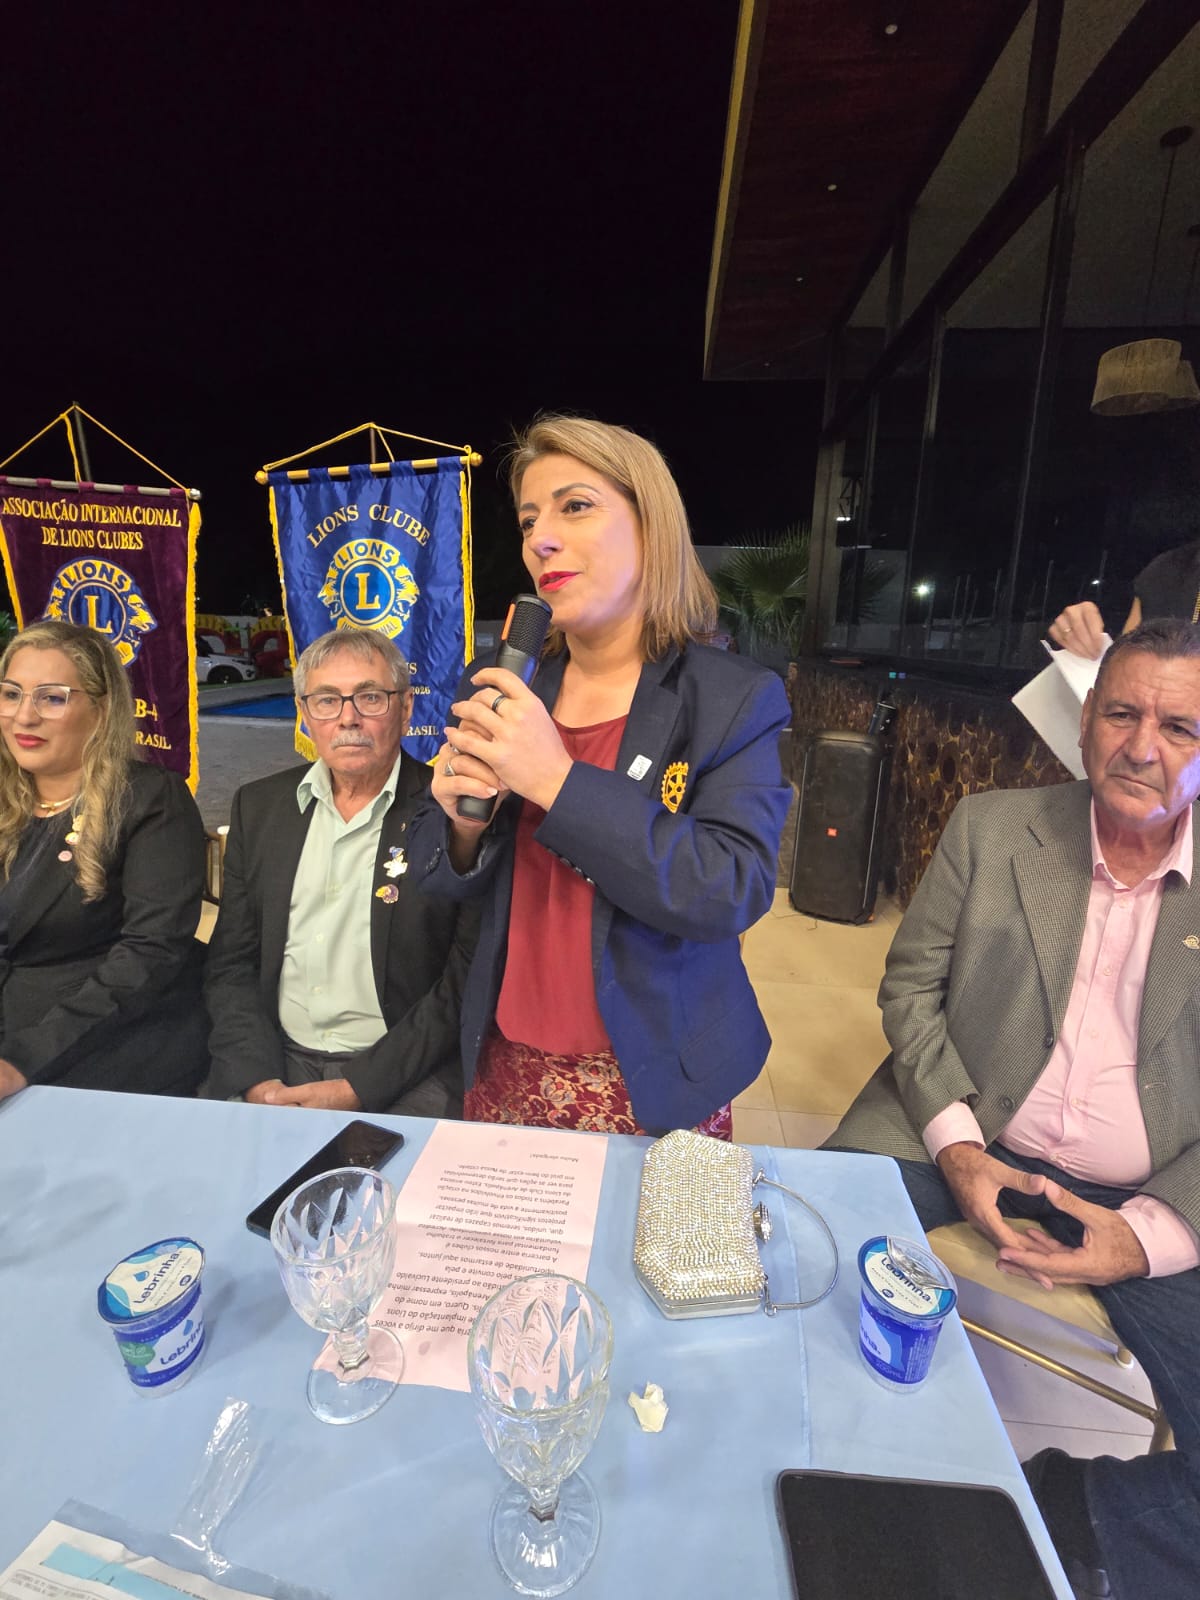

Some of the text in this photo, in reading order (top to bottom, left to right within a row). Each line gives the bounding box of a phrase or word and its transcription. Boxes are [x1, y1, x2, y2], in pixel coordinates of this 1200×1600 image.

[2, 497, 182, 527] ASSOCIAÇÃO INTERNACIONAL
[307, 504, 430, 548] LIONS CLUBE
[41, 526, 144, 550] DE LIONS CLUBES
[337, 542, 395, 566] LIONS
[62, 562, 127, 589] LIONS
[355, 573, 381, 610] L
[84, 595, 113, 633] L
[134, 698, 158, 721] B-4
[406, 725, 440, 736] RASIL
[135, 731, 171, 750] RASIL
[463, 1237, 496, 1245] fortalecer
[515, 1243, 559, 1254] fundamental
[461, 1257, 493, 1266] estarmos
[522, 1252, 550, 1261] parceria
[134, 1252, 180, 1304] Lebrinha
[396, 1272, 430, 1282] Lucivaldo
[468, 1269, 495, 1277] convite
[432, 1276, 470, 1286] presidente
[388, 1283, 411, 1291] minha
[411, 1287, 447, 1295] expressar
[444, 1302, 469, 1310] Quero,
[387, 1309, 406, 1317] Lions
[420, 1312, 467, 1322] implantação
[404, 1323, 424, 1332] dirijo
